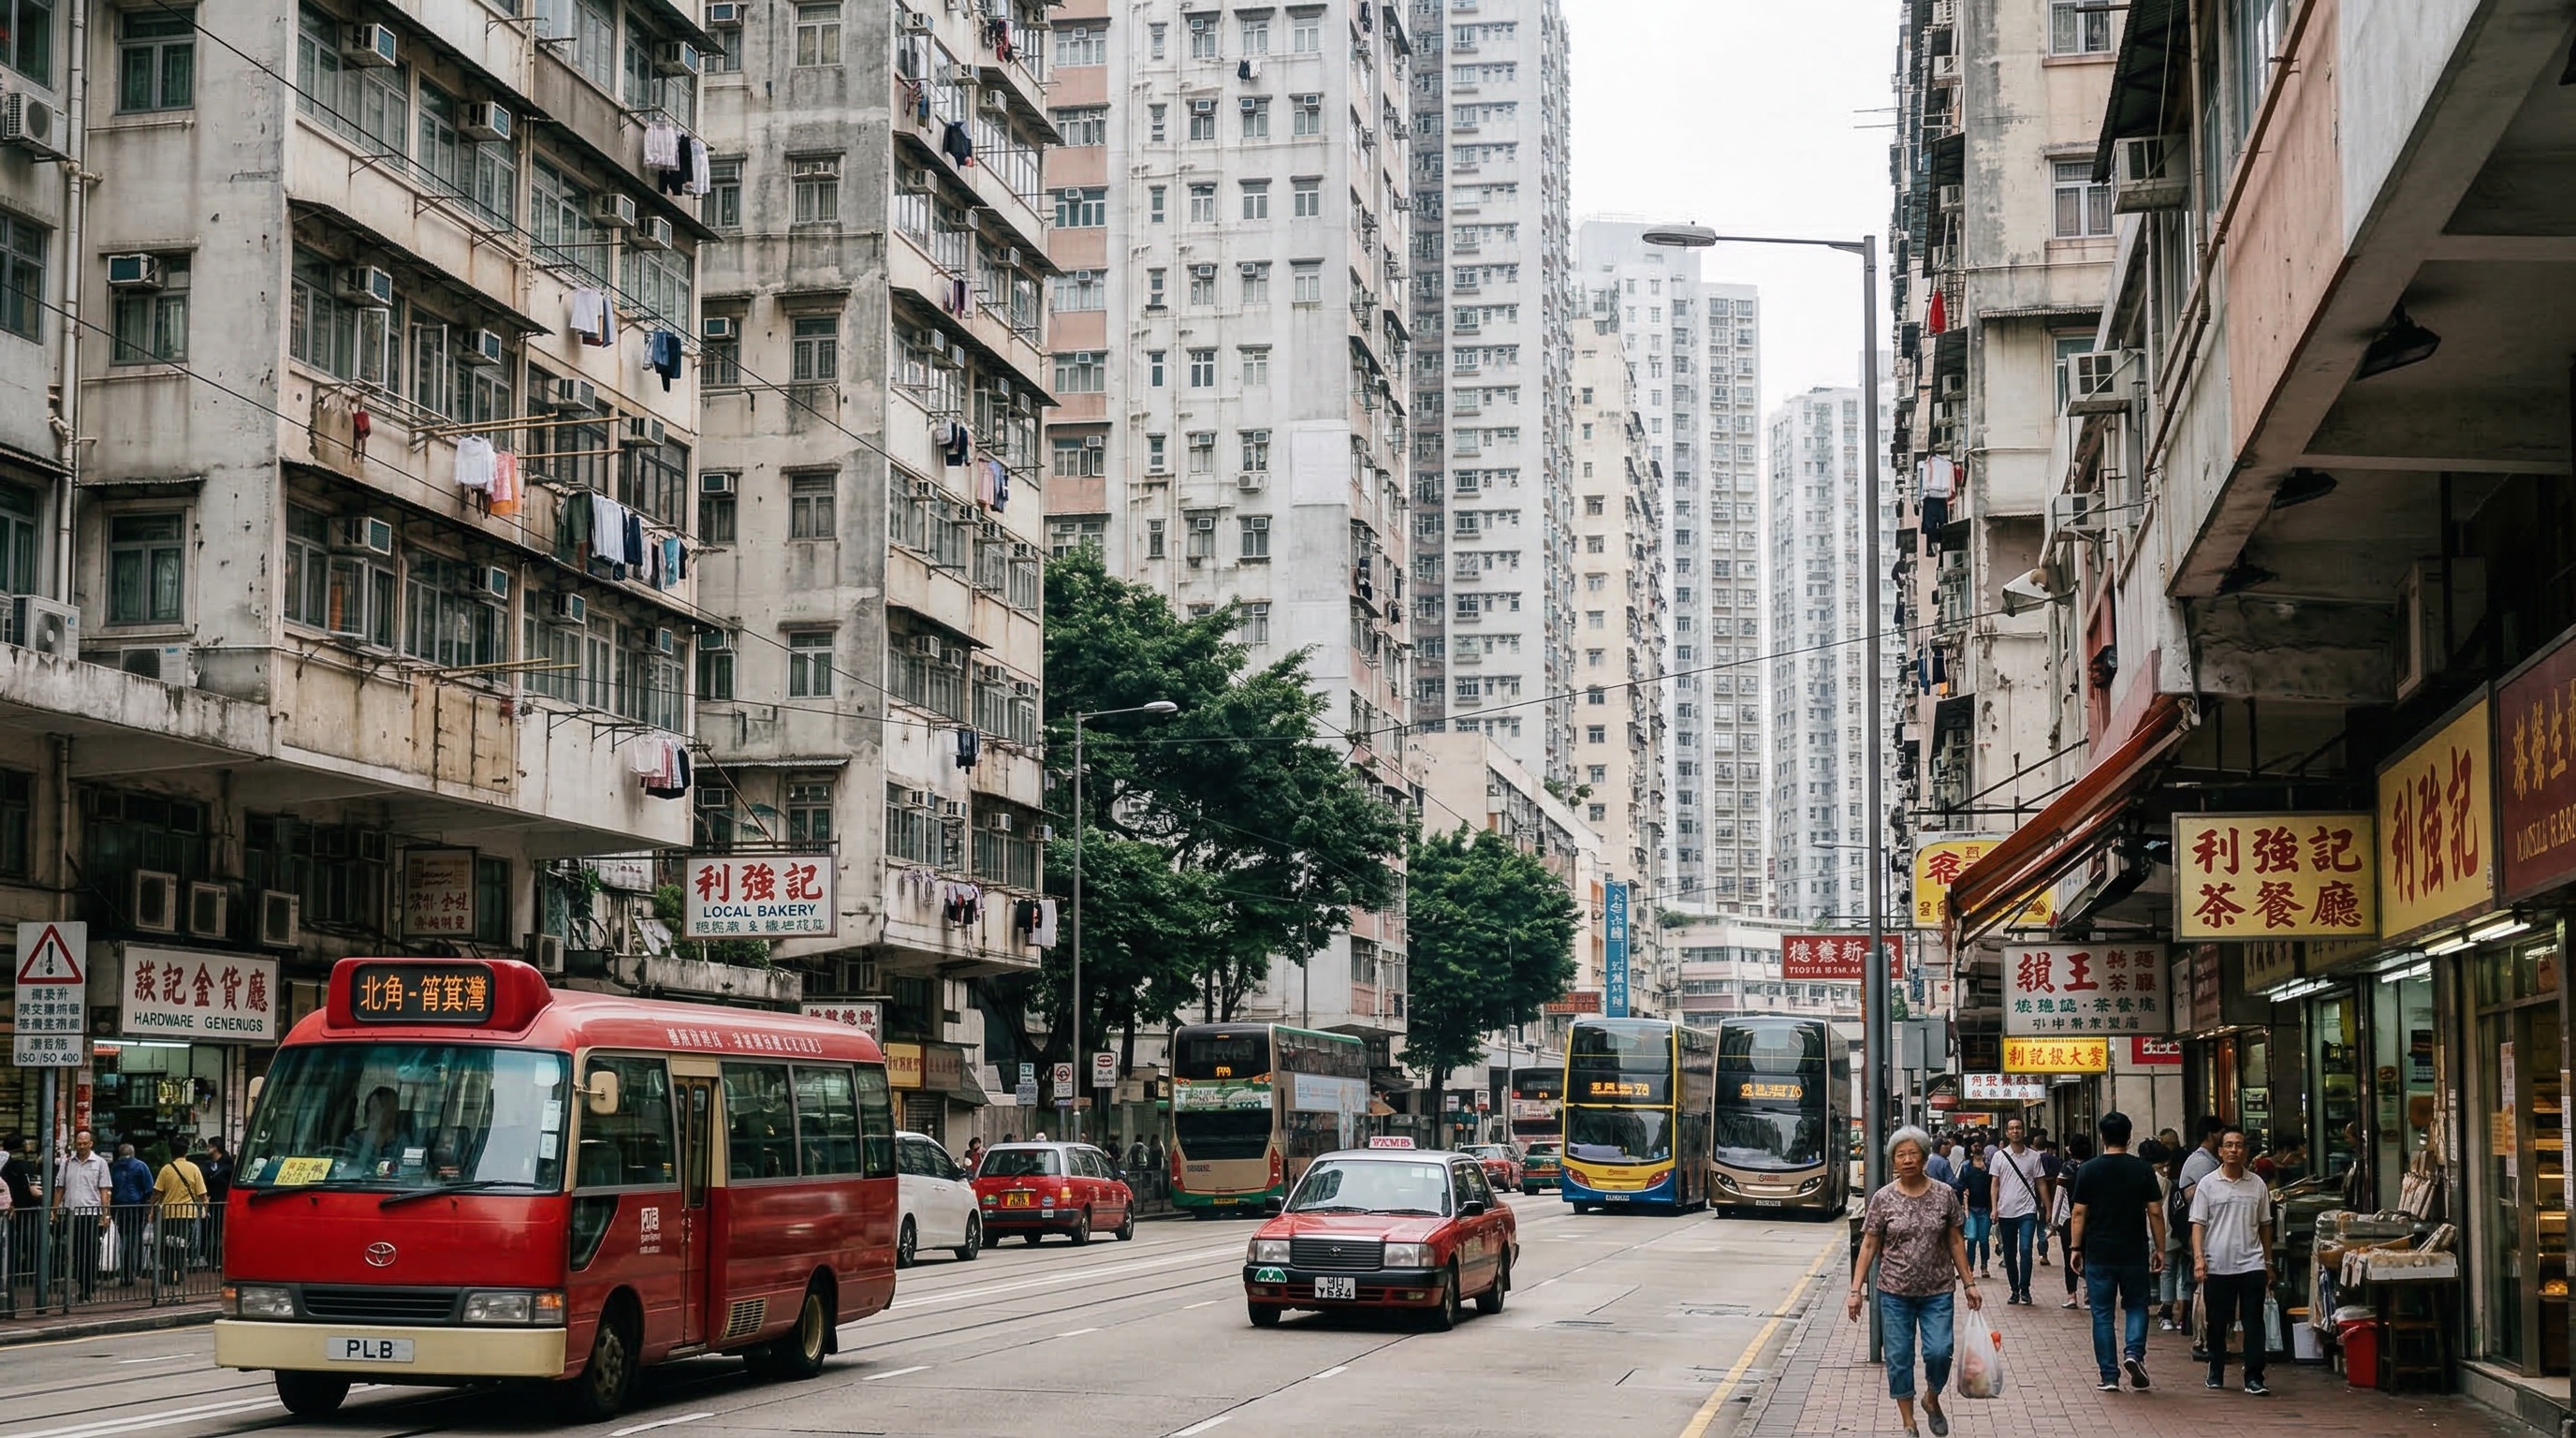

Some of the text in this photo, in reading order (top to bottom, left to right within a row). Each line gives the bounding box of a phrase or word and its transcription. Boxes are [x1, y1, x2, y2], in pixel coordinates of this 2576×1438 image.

[2392, 745, 2479, 907] 利強記
[2191, 825, 2364, 875] 利強記
[695, 862, 824, 903] 利強記
[703, 903, 817, 918] LOCAL BAKERY
[2192, 880, 2364, 930] 茶餐廳
[134, 1011, 263, 1033] HARDWARE GENERUGS
[61, 1051, 80, 1064] 400
[346, 1339, 393, 1359] PLB
